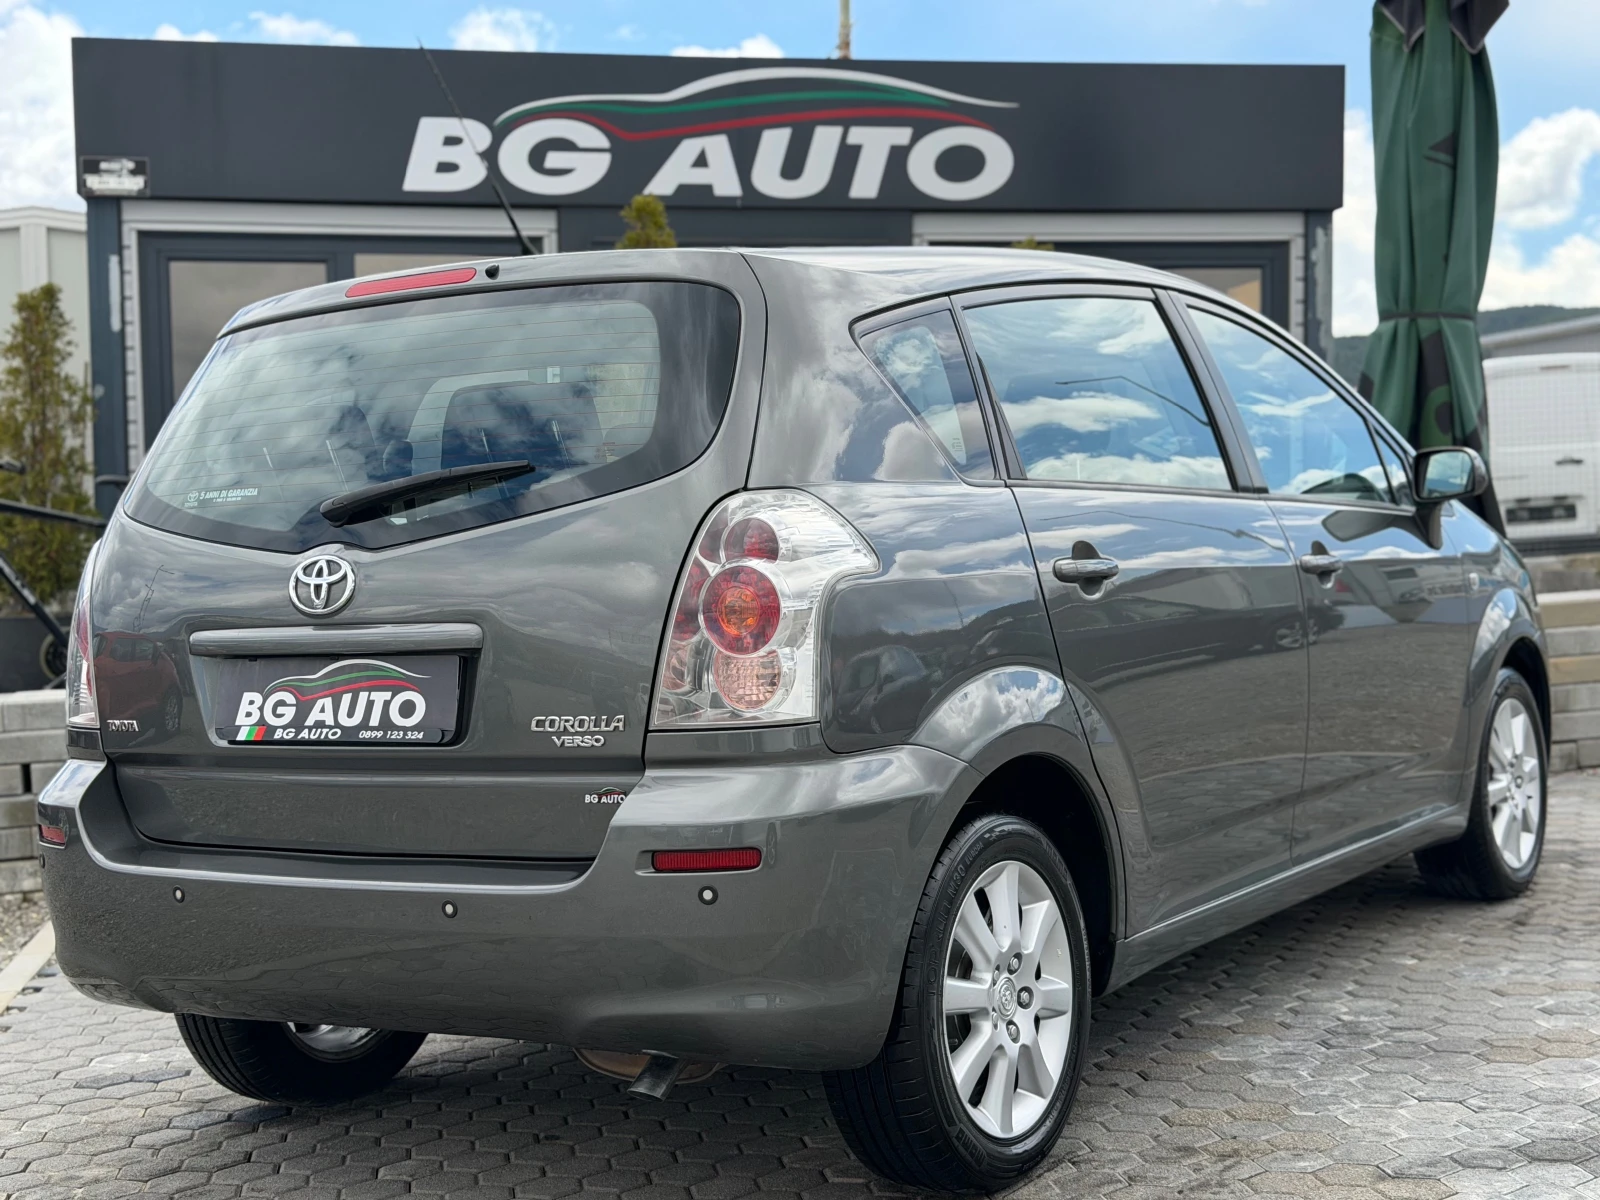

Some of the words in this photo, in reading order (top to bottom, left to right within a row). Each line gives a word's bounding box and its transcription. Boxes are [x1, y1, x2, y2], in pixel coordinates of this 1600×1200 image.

[402, 116, 612, 196] BG
[642, 125, 1015, 201] AUTO
[199, 491, 206, 500] 5
[205, 490, 221, 499] ANNI
[220, 489, 228, 498] DI
[228, 488, 258, 497] GARANZIA
[235, 691, 297, 726] BG
[304, 690, 426, 727] AUTO
[106, 719, 139, 731] TOYOTA
[530, 715, 625, 732] COROLLA
[273, 728, 296, 740] BG
[297, 728, 341, 740] AUTO
[358, 730, 383, 739] 0899
[386, 730, 404, 739] 123
[405, 731, 424, 739] 324
[551, 735, 605, 748] VERSO
[584, 794, 598, 804] BG
[600, 794, 626, 804] AUTO
